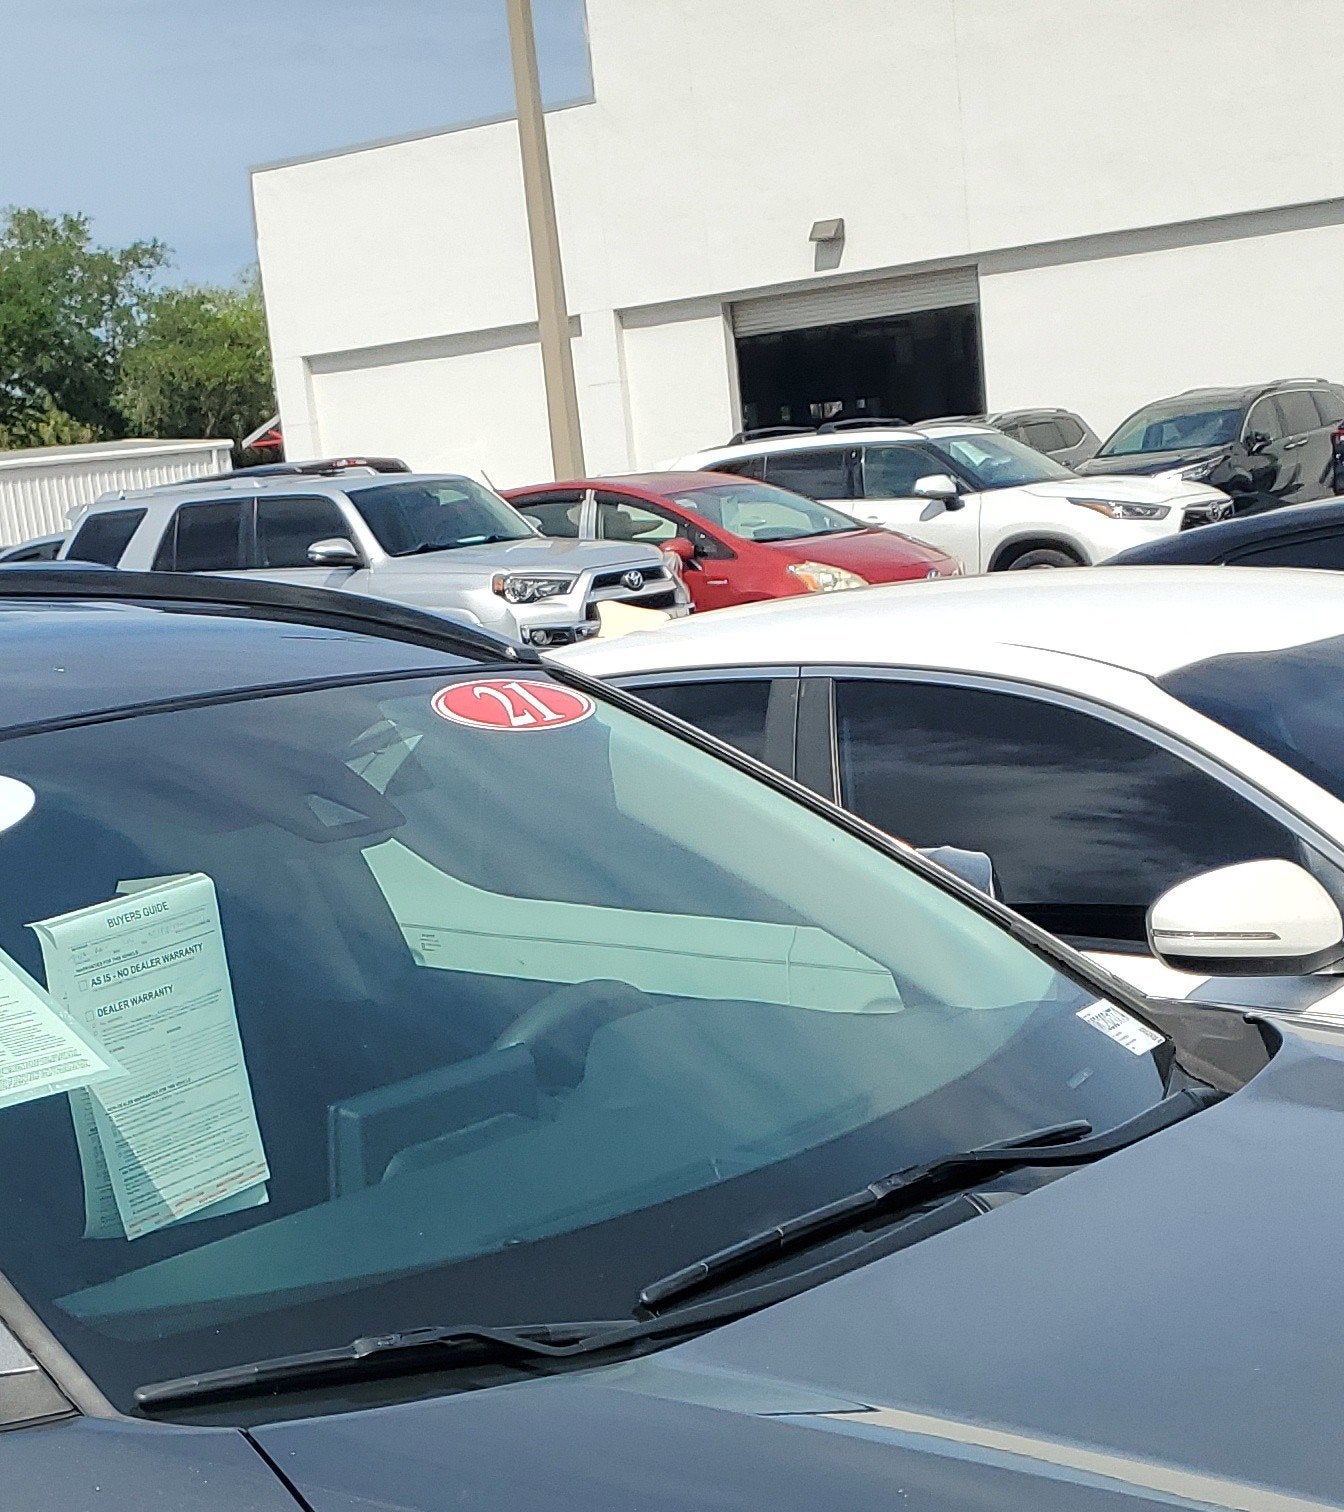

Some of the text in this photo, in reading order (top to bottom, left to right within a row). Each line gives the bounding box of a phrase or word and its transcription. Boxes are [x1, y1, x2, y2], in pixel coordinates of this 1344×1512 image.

[473, 681, 566, 727] 21
[107, 901, 169, 928] BUYERS GUIDE
[91, 976, 102, 987] AS
[103, 972, 112, 983] IS
[117, 968, 129, 978] NO
[131, 957, 162, 975] DEALER
[162, 943, 203, 963] WARRANTY
[97, 984, 173, 1017] DEALER WARRANTY
